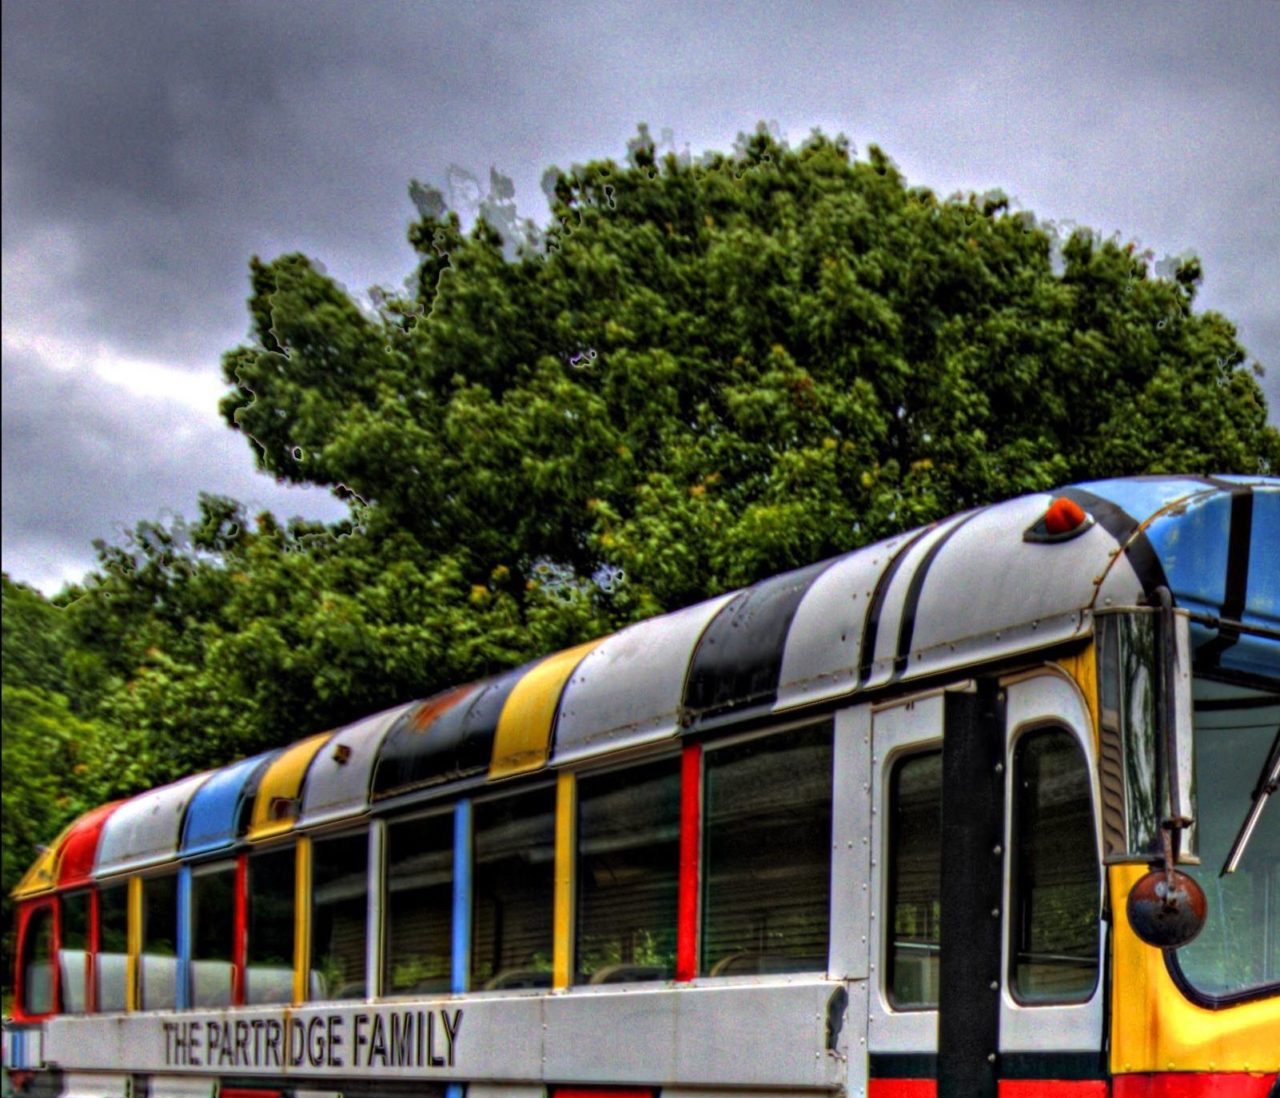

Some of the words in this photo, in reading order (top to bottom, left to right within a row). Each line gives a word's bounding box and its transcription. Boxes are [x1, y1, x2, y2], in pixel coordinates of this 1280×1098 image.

[163, 1021, 201, 1067] THE
[206, 1016, 343, 1067] PARTRIDGE
[353, 1009, 463, 1067] FAMILY
